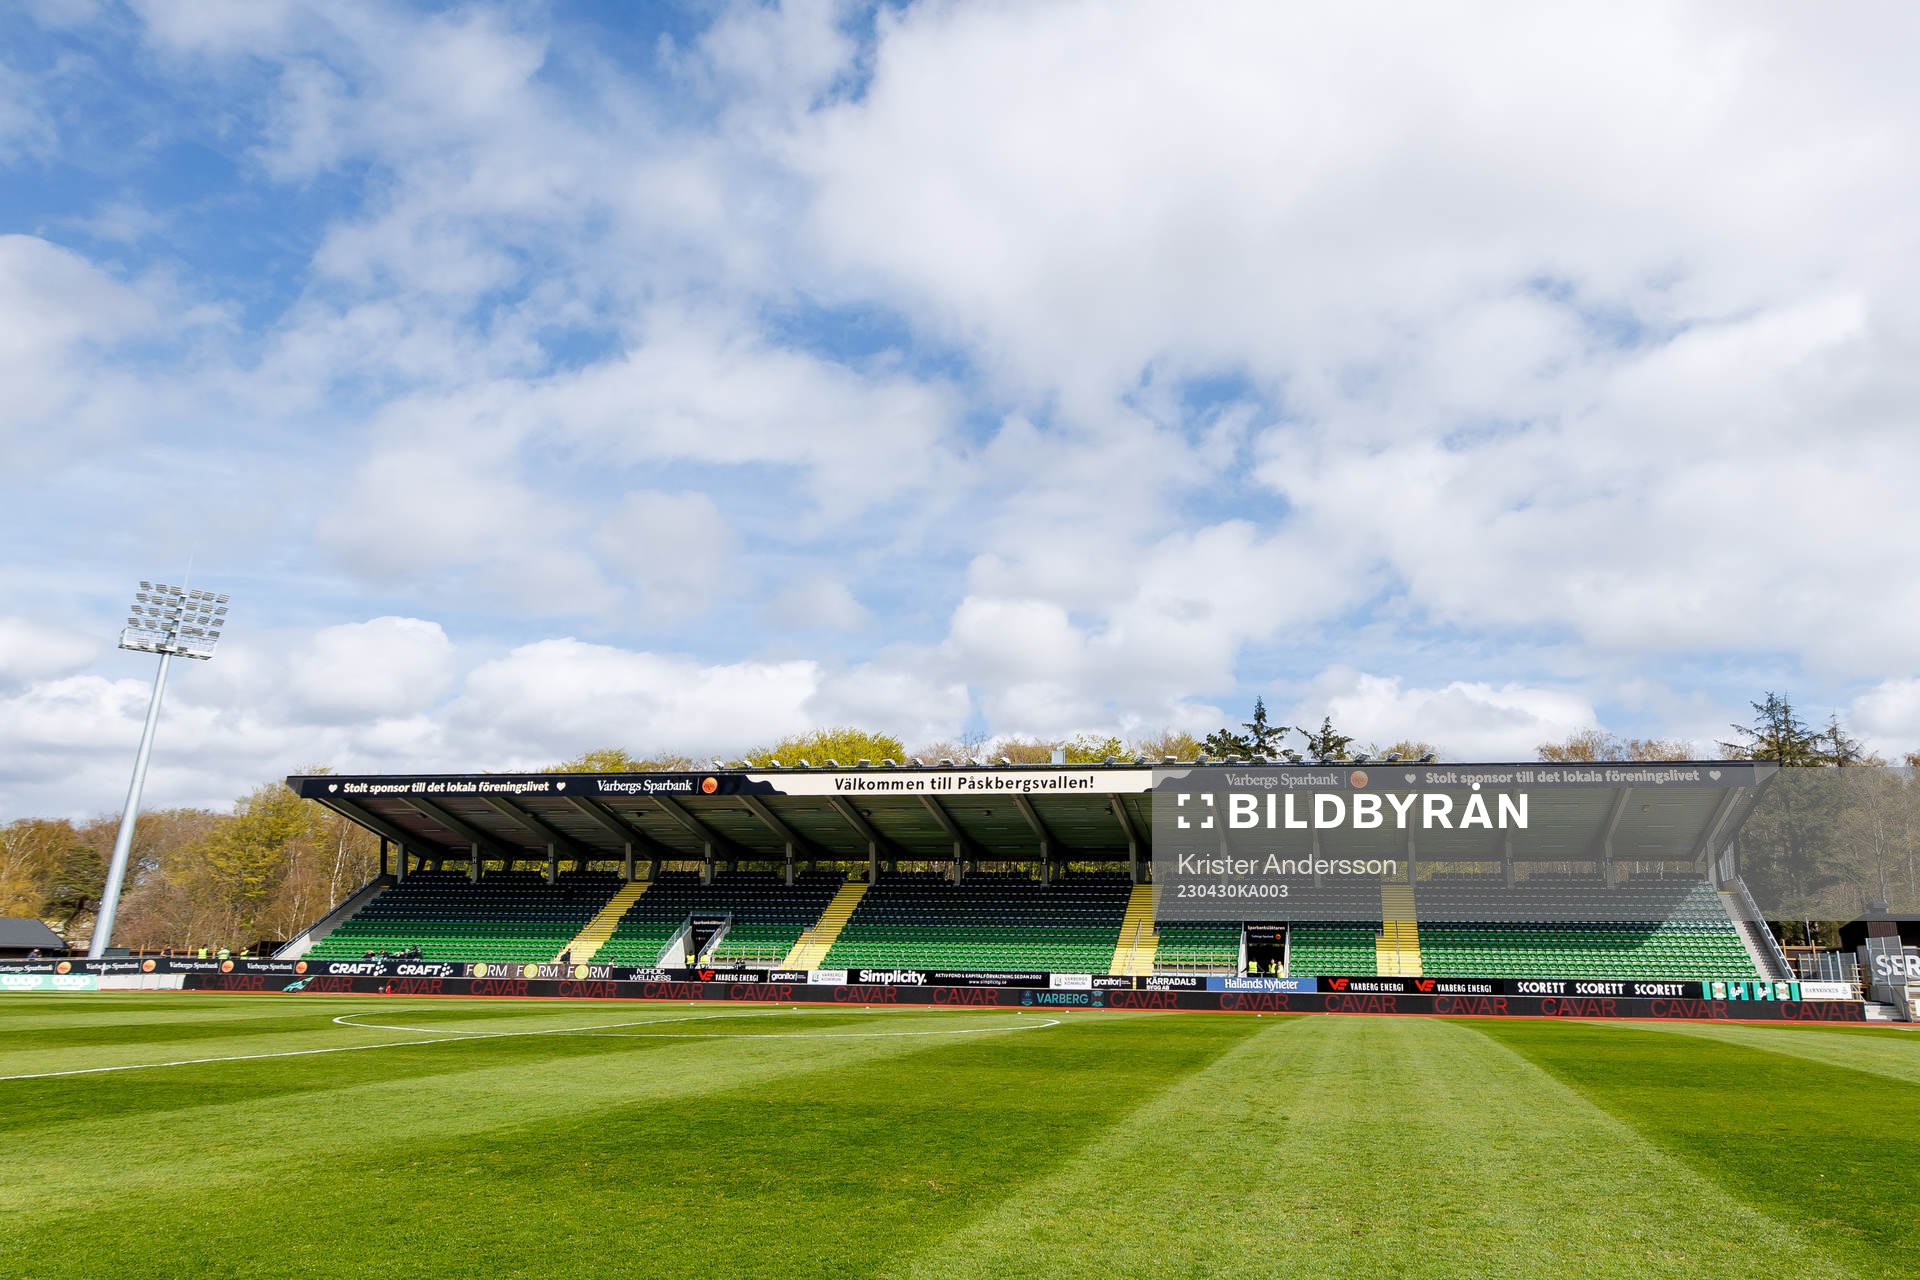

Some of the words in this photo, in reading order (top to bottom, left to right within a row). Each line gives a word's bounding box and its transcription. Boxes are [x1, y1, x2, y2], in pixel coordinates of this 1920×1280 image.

[835, 777, 924, 791] Välkommen
[930, 776, 952, 790] till
[958, 775, 1094, 792] Påskbergsvallen!
[1225, 773, 1278, 789] Varbergs
[1281, 773, 1339, 789] Sparbank
[1425, 772, 1457, 784] Stolt
[1460, 773, 1513, 787] sponsor
[1516, 771, 1534, 783] till
[1537, 771, 1560, 783] det
[1563, 771, 1602, 783] lokala
[1605, 769, 1699, 785] föreningslivet
[343, 783, 368, 793] Stolt
[369, 784, 411, 796] sponsor
[411, 782, 425, 793] till
[427, 782, 445, 793] det
[446, 781, 477, 793] lokala
[479, 781, 549, 795] föreningslivet
[597, 780, 641, 795] Varbergs
[643, 779, 693, 795] Sparbank
[0, 965, 24, 973] arbergs
[328, 963, 376, 974] CRAFT
[396, 964, 442, 976] CRAFT
[204, 975, 265, 991] CAVAR
[385, 977, 444, 994] CAVAR
[715, 974, 738, 982] VARBERG
[739, 974, 759, 982] ENERGI
[859, 970, 927, 986] Simplicity.
[1146, 976, 1196, 986] KÄRRADALS
[1225, 978, 1263, 990] Hallands
[1264, 979, 1299, 991] Nyheter
[470, 980, 529, 997] CAVAR
[559, 981, 617, 998] CAVAR
[643, 982, 704, 999] CAVAR
[730, 984, 793, 1001] CAVAR
[834, 985, 897, 1003] CAVAR
[1350, 982, 1380, 992] VARBERG
[1381, 983, 1404, 993] ENERGI
[1437, 983, 1467, 993] VARBERG
[1468, 984, 1492, 993] ENERGI
[1518, 981, 1565, 994] SCORETT
[1576, 982, 1624, 995] SCORETT
[1635, 984, 1684, 996] SCORETT
[932, 987, 999, 1005] CAVAR
[1036, 993, 1089, 1005] VARBERG
[1109, 991, 1178, 1008] CAVAR
[1219, 993, 1289, 1010] CAVAR
[1325, 994, 1397, 1012] CAVAR
[1434, 996, 1509, 1015] CAVAR
[1541, 997, 1616, 1016] CAVAR
[1650, 1000, 1728, 1018] CAVAR
[1781, 1002, 1861, 1020] CAVAR
